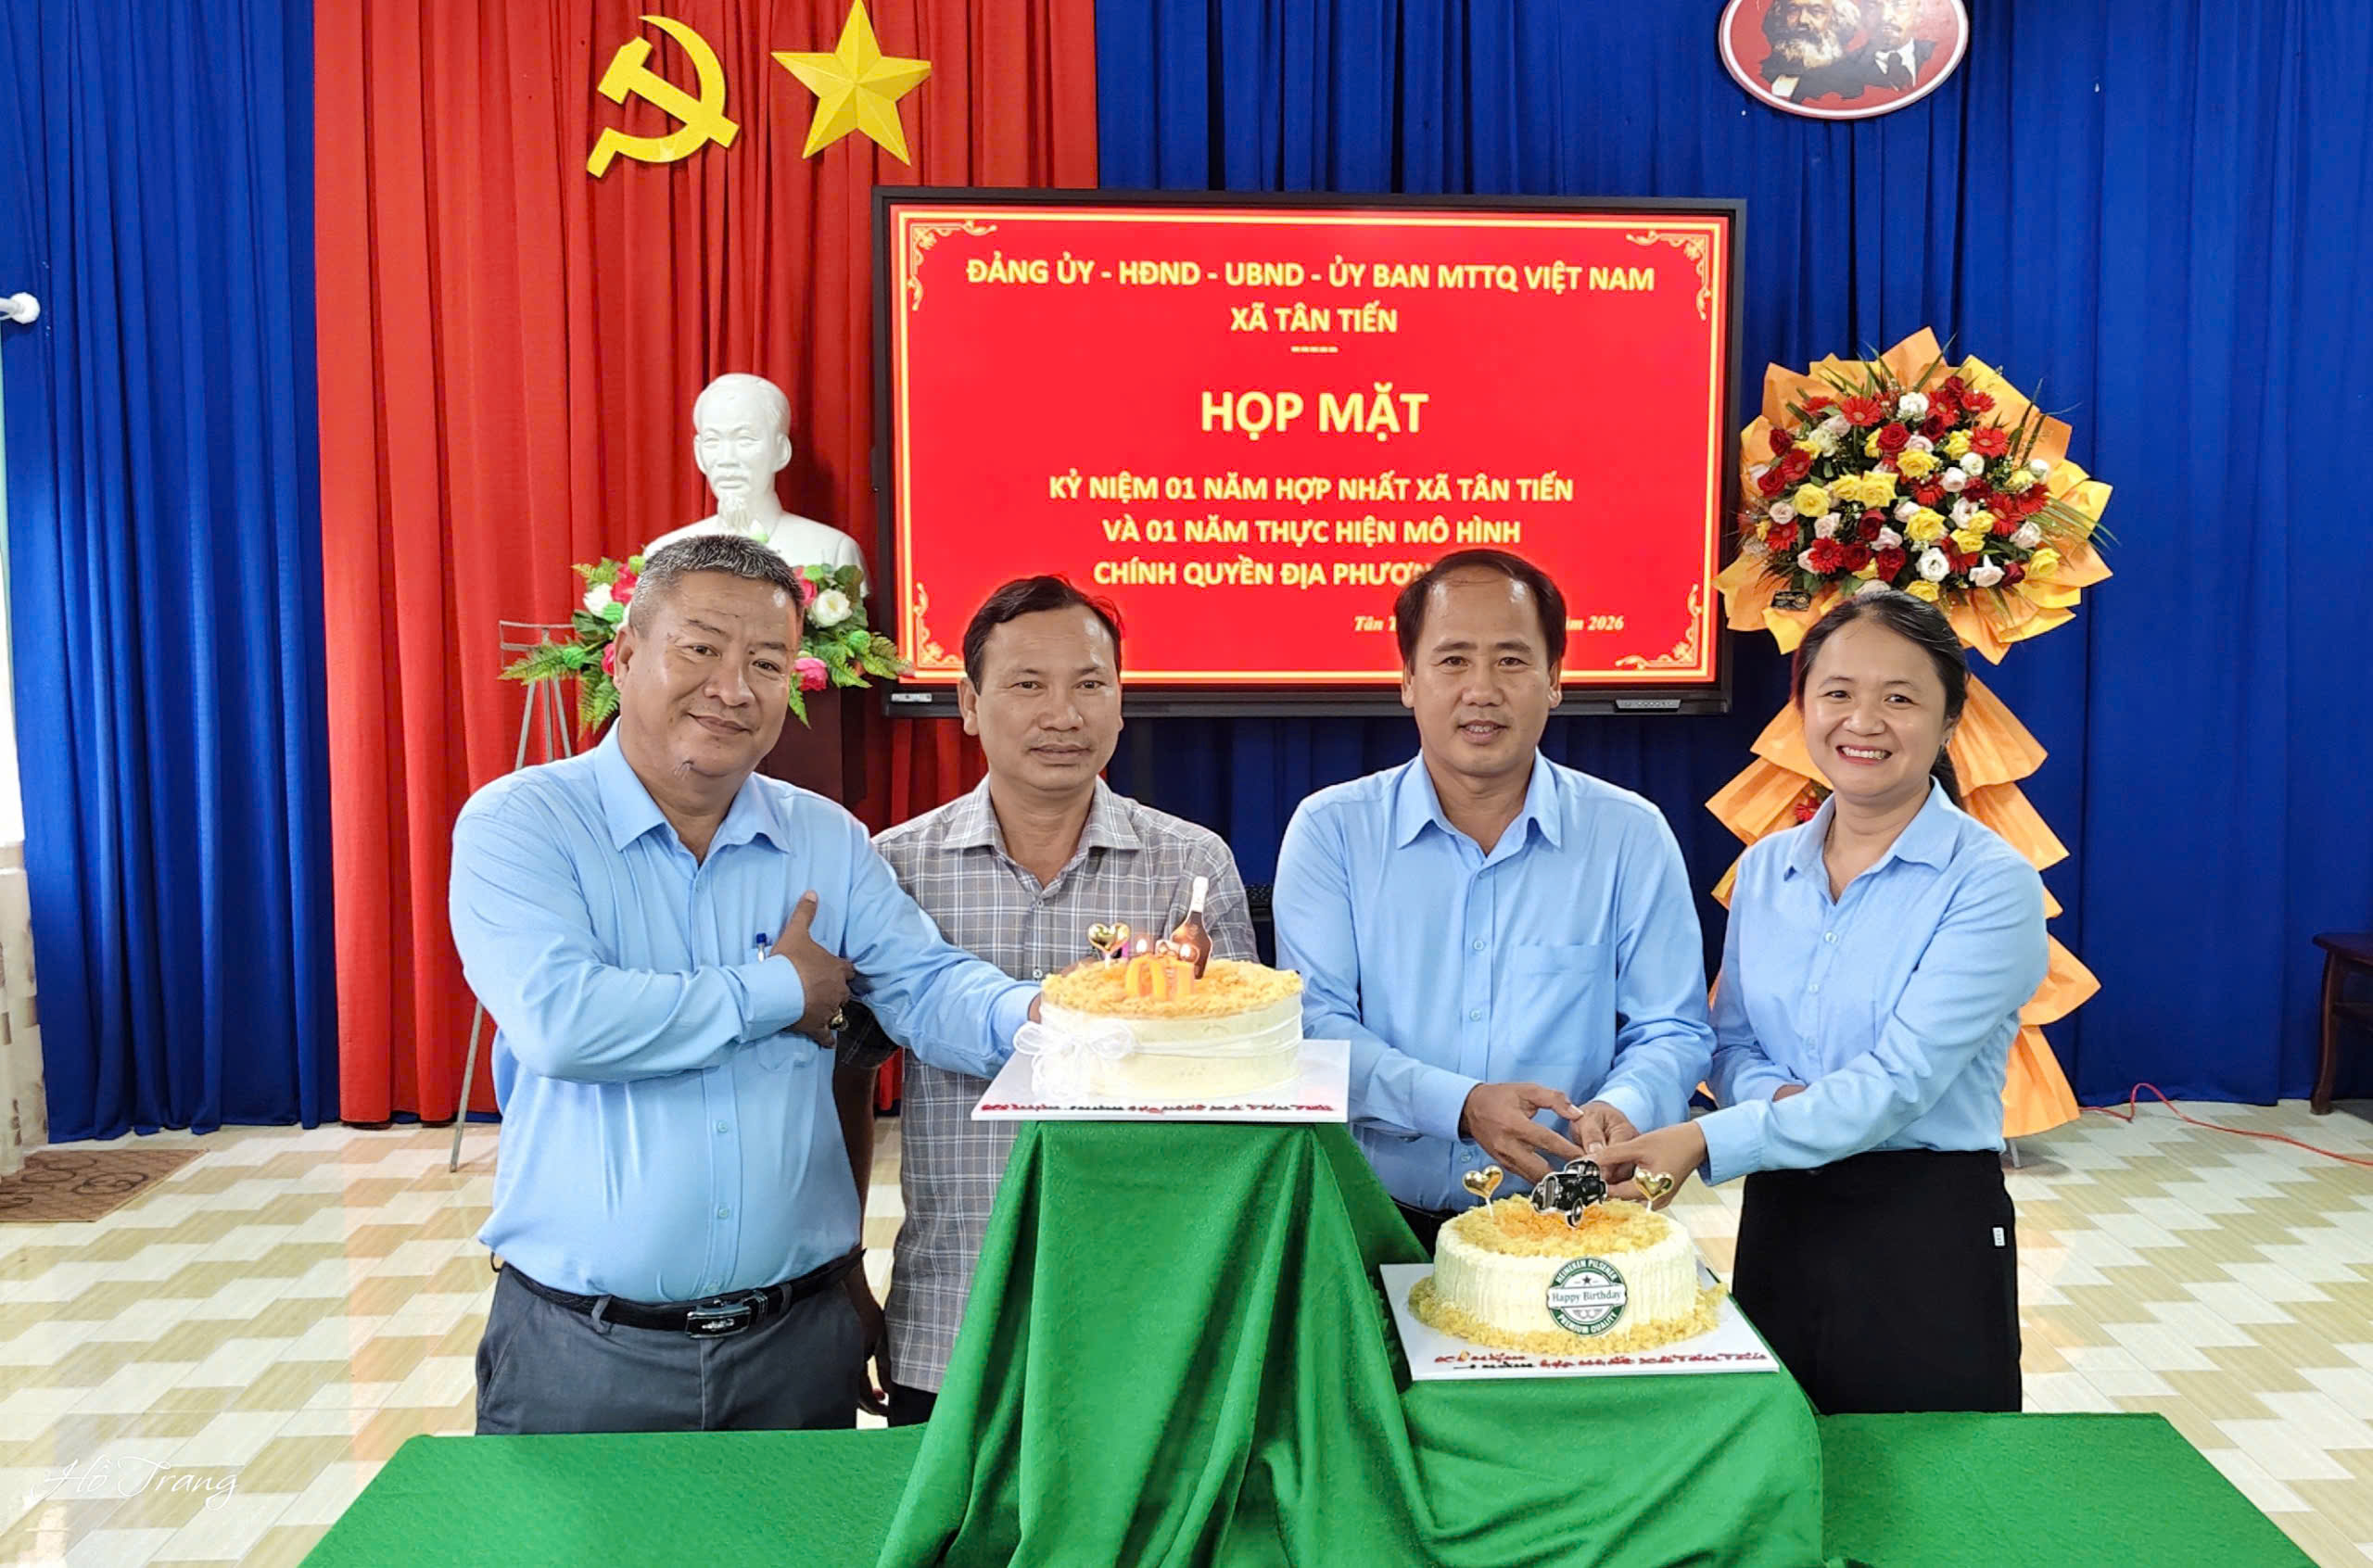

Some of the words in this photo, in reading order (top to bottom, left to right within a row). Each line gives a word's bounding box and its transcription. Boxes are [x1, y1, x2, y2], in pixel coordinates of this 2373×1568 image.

[966, 250, 1048, 284] ĐẢNG
[1057, 251, 1095, 285] ỦY
[1119, 260, 1200, 285] HĐND
[1225, 262, 1304, 287] UBND
[1328, 254, 1365, 287] ỦY
[1373, 263, 1429, 288] BAN
[1438, 264, 1519, 293] MTTQ
[1524, 259, 1583, 295] VIỆT
[1590, 266, 1655, 291] NAM
[1230, 301, 1269, 332] XÃ
[1274, 301, 1330, 332] TÂN
[1337, 299, 1398, 332] TIẾN
[1201, 391, 1304, 441] HỌP
[1318, 381, 1429, 442] MẶT
[1049, 467, 1083, 499] KỶ
[1089, 470, 1159, 504] NIỆM
[1164, 476, 1197, 500] 01
[1203, 471, 1268, 500] NĂM
[1275, 476, 1332, 505] HỢP
[1338, 469, 1411, 501] NHẤT
[1415, 473, 1452, 501] XÃ
[1457, 473, 1510, 501] TÂN
[1516, 470, 1574, 501] TIẾN
[1101, 513, 1140, 542] VÀ
[1145, 519, 1178, 543] 01
[1184, 513, 1249, 543] NĂM
[1254, 518, 1329, 548] THỰC
[1335, 514, 1396, 548] HIỆN
[1402, 514, 1450, 544] MÔ
[1456, 514, 1521, 544] HÌNH
[1093, 555, 1176, 585] CHÍNH
[1183, 553, 1274, 588] QUYỀN
[1279, 562, 1327, 590] ĐỊA
[1354, 615, 1384, 631] Tân
[1587, 615, 1625, 631] 2026
[1551, 1292, 1580, 1304] Happy
[1583, 1289, 1621, 1301] Birthday
